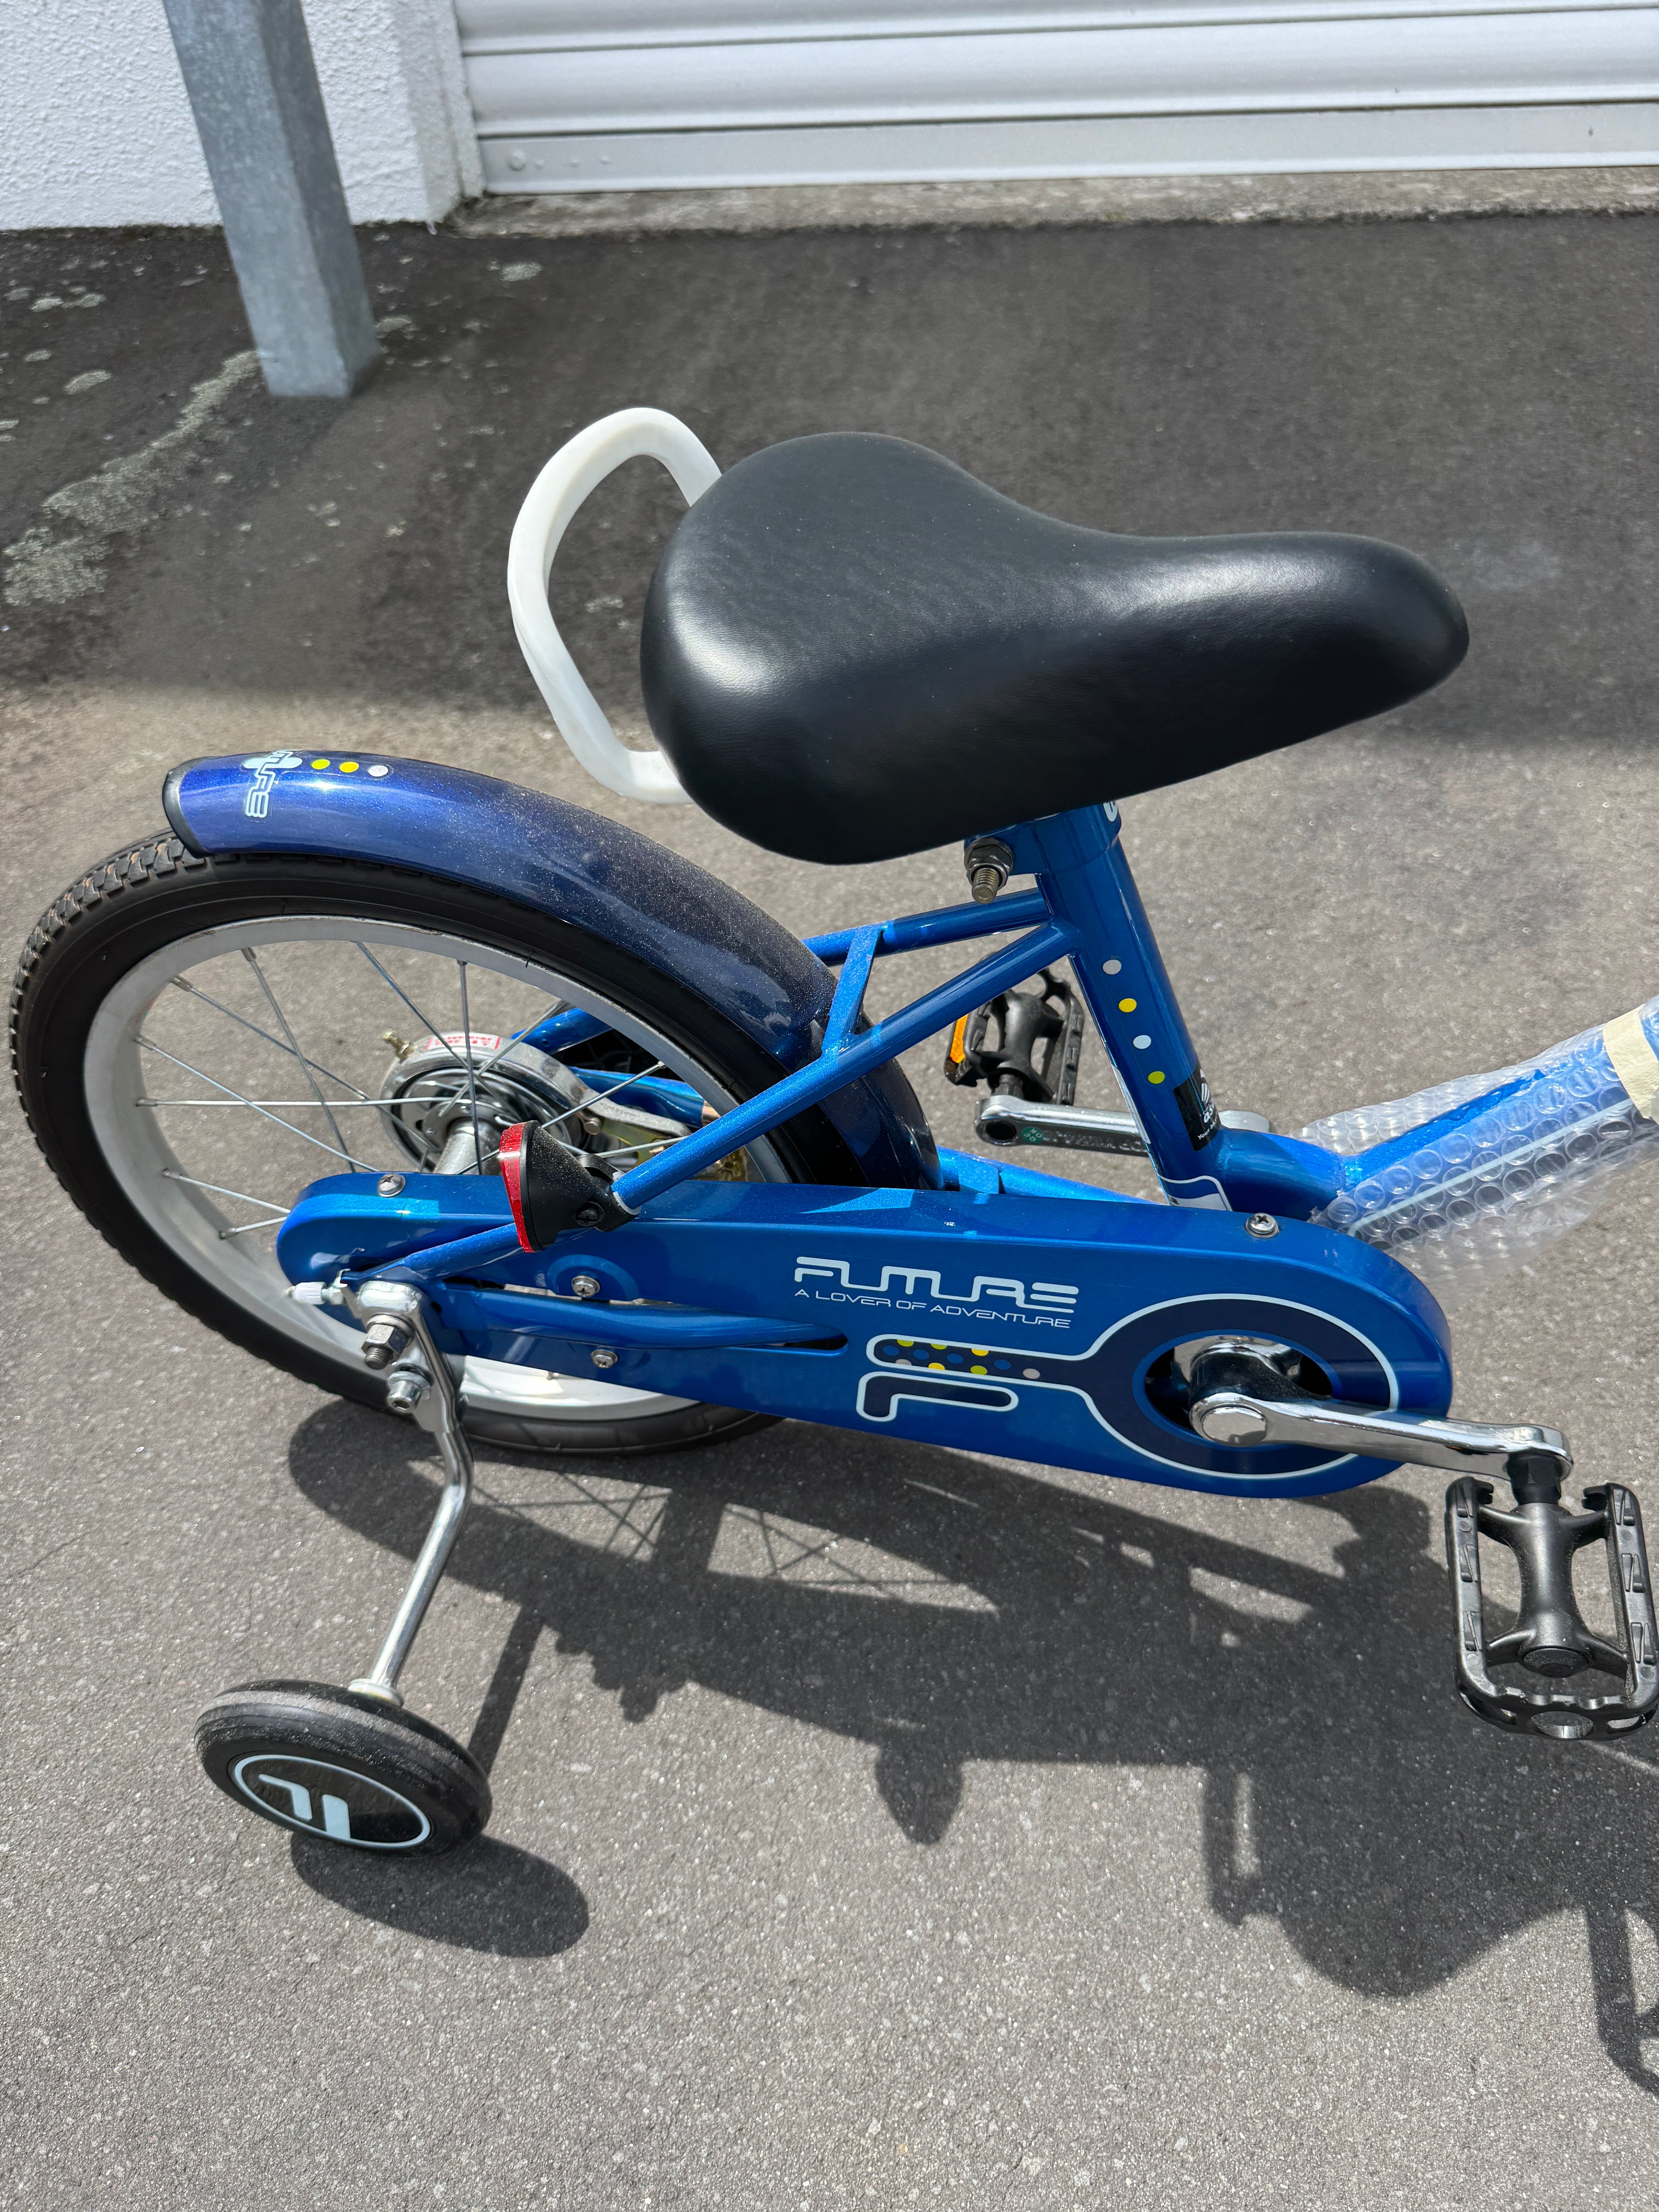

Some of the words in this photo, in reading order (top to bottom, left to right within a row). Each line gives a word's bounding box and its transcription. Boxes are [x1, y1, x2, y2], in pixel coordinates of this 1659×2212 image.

[1198, 1129, 1210, 1140] Your
[794, 1256, 1079, 1313] FUTURE
[795, 1289, 810, 1298] A
[816, 1290, 891, 1307] LOVER
[896, 1300, 927, 1310] OF
[930, 1304, 1072, 1329] ADVENTURE
